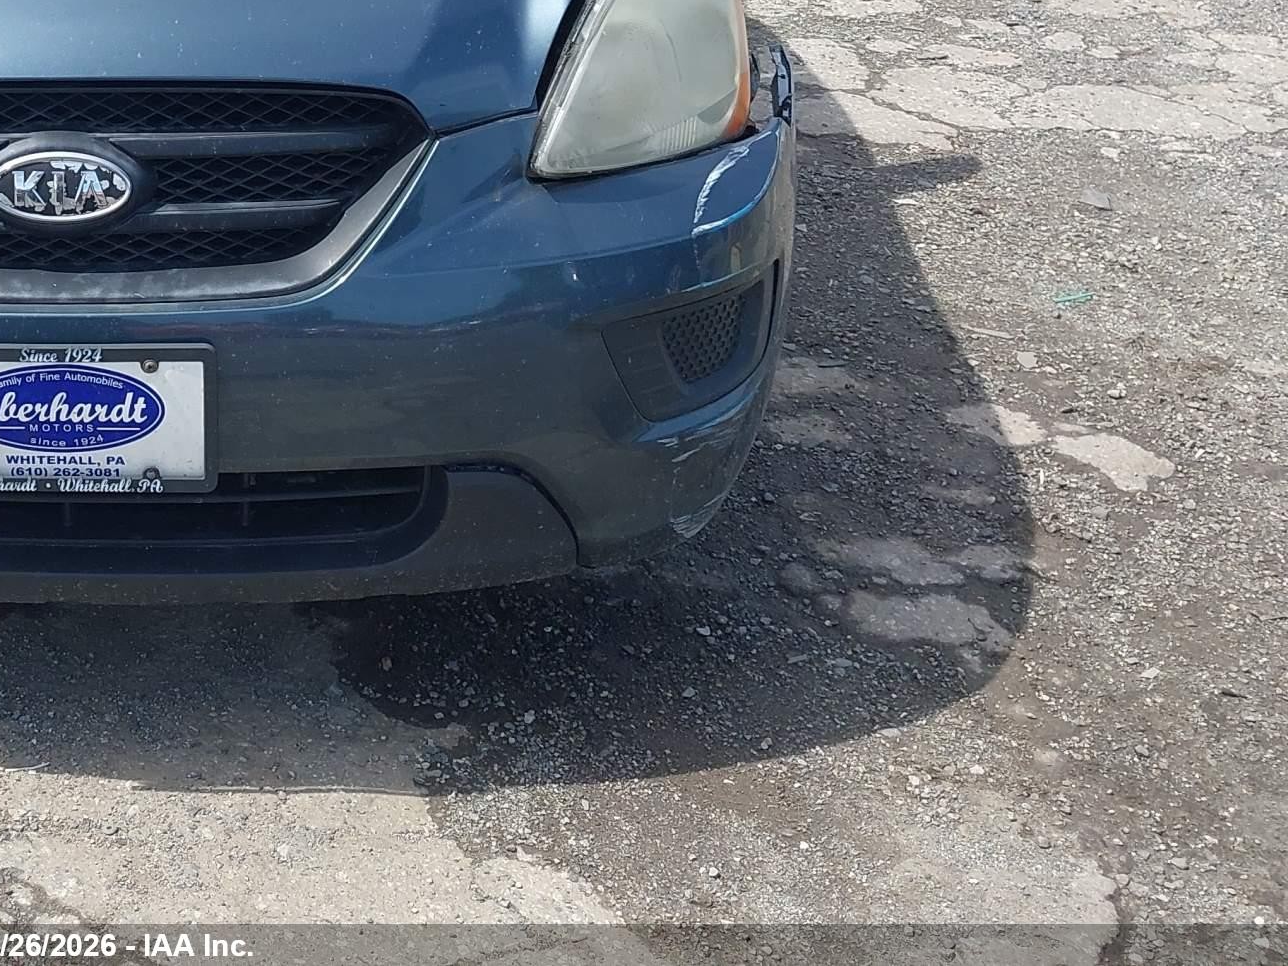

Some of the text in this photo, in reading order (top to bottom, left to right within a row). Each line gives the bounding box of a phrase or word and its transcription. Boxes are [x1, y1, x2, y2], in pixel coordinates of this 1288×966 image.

[11, 170, 108, 208] KIA
[19, 347, 103, 363] Since 1924
[25, 373, 36, 383] of
[39, 372, 61, 382] Fine
[64, 372, 124, 389] Automobiles
[29, 424, 95, 433] MOTORS
[30, 434, 105, 447] since 1924
[6, 455, 126, 466] WHITEHALL, PA
[10, 467, 120, 477] (610) 262-3081
